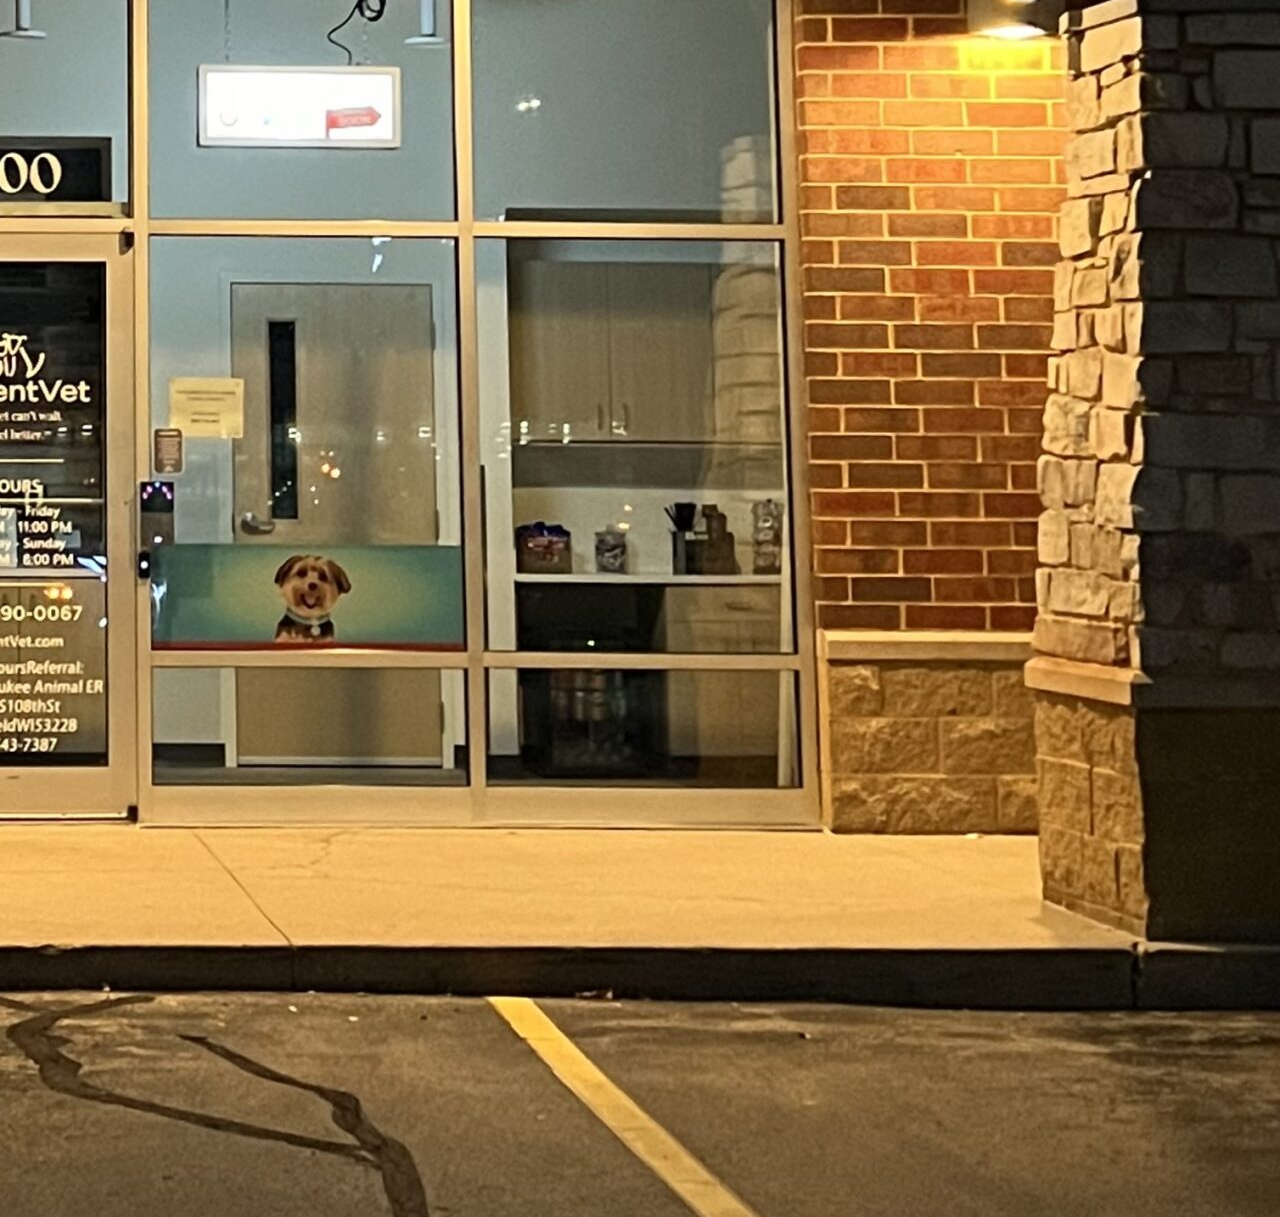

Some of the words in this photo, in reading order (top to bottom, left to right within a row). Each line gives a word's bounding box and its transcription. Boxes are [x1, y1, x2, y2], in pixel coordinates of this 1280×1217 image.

[12, 410, 37, 422] can't
[25, 505, 60, 519] Friday
[18, 521, 48, 533] 11:00
[51, 521, 72, 533] PM
[23, 538, 66, 551] Sunday
[53, 554, 74, 565] PM
[33, 679, 83, 694] Animal
[86, 680, 104, 694] ER
